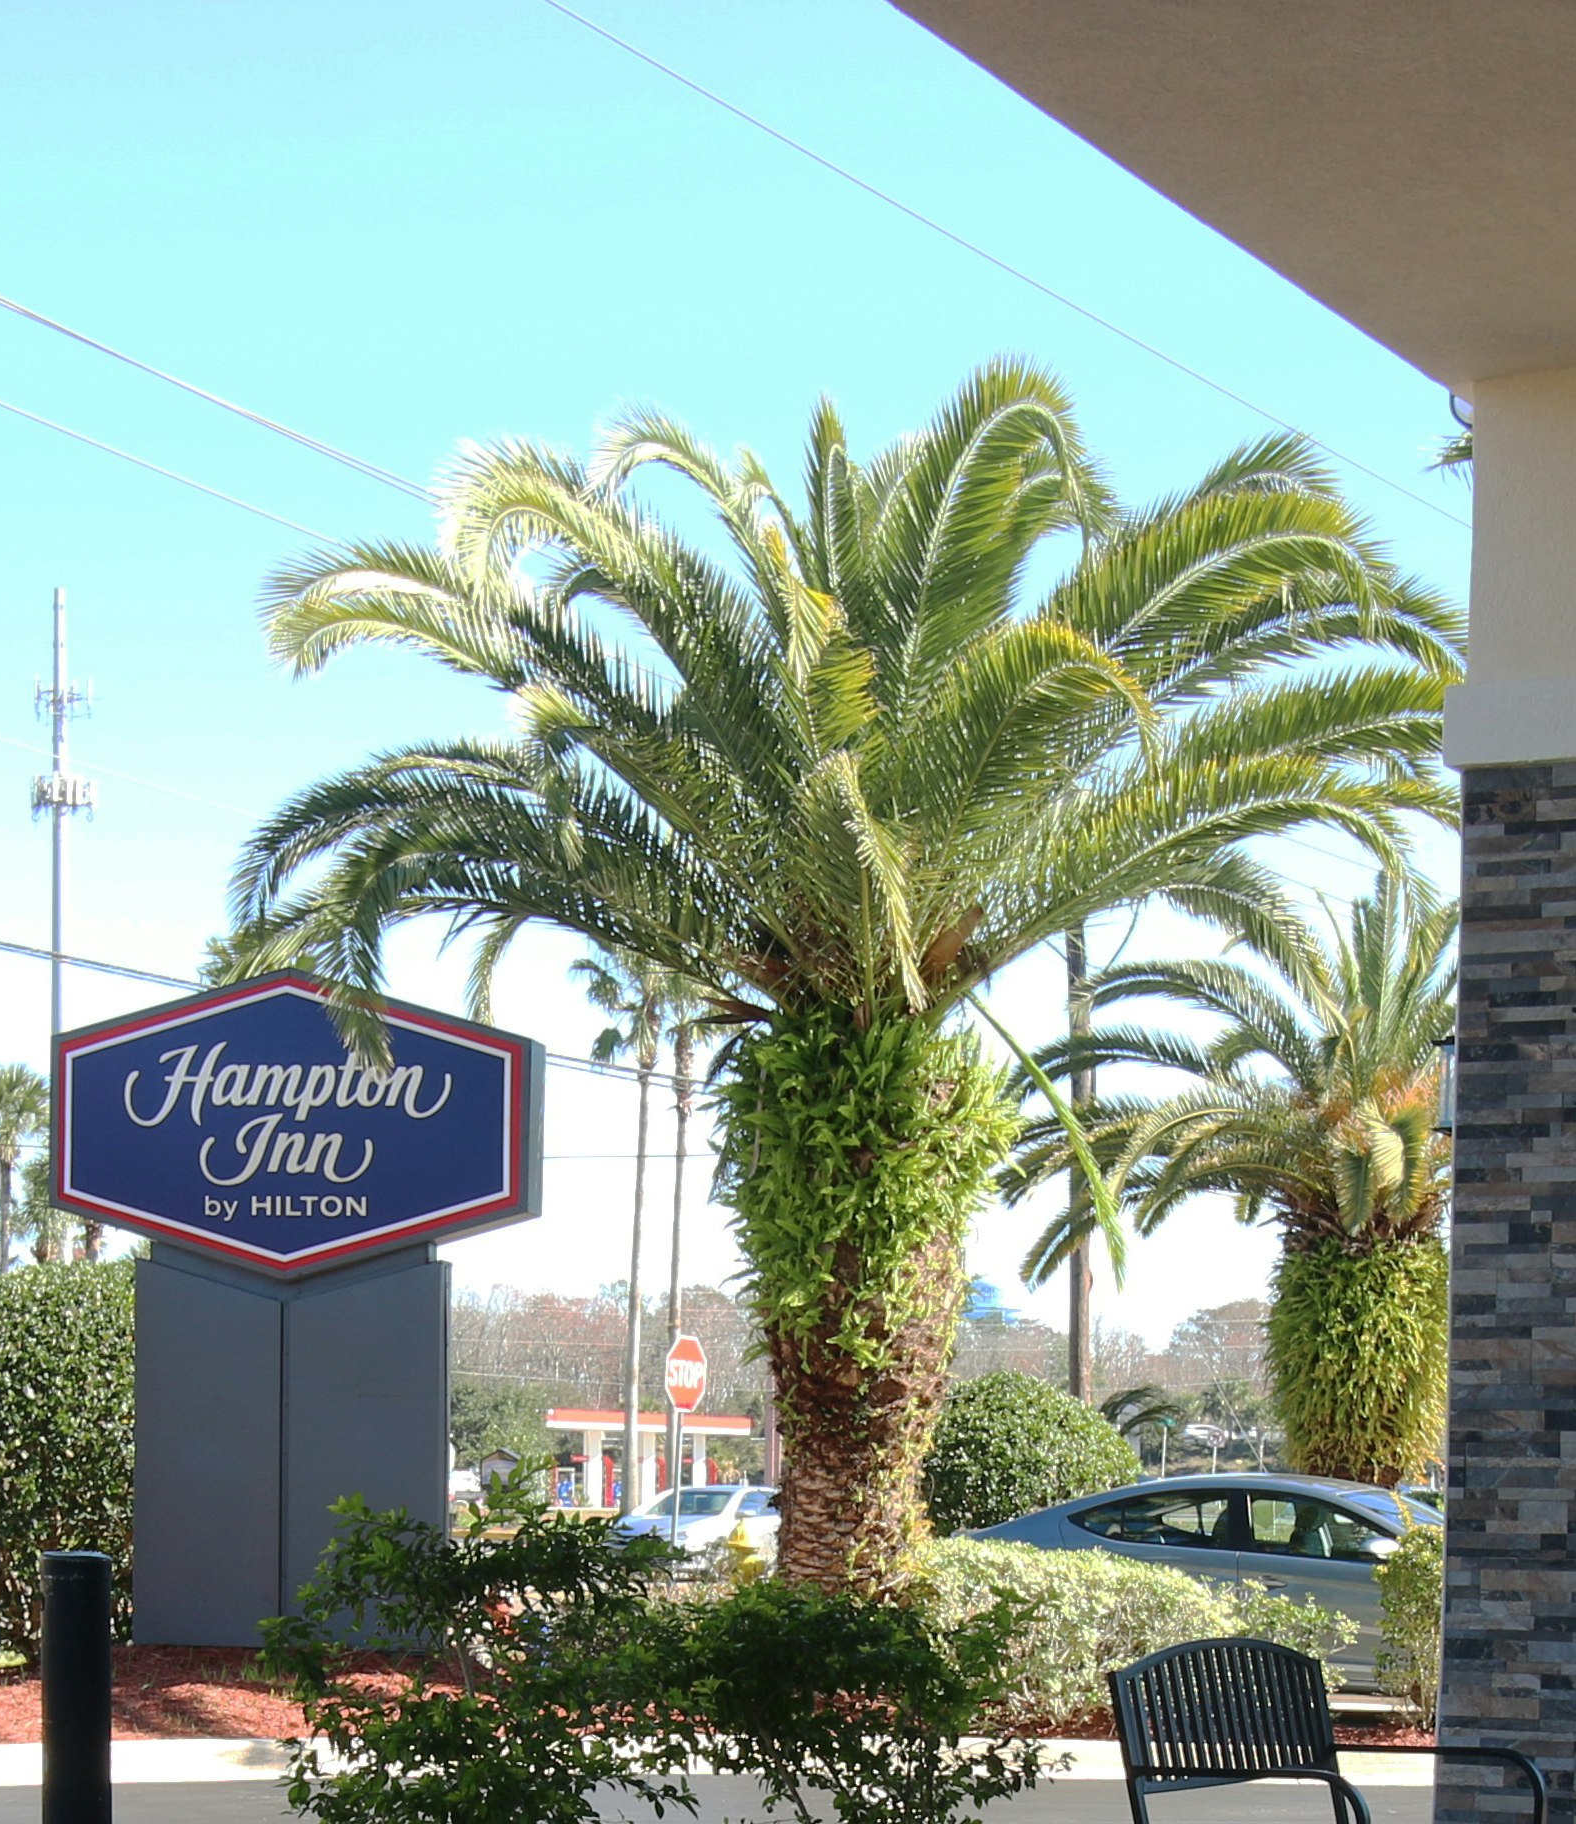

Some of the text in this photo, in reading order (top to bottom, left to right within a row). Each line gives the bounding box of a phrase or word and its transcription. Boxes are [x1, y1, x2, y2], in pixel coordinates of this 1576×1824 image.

[124, 1041, 453, 1128] Hampton
[199, 1113, 374, 1186] Inn
[204, 1195, 367, 1222] by HILTON
[667, 1359, 704, 1389] STOP
